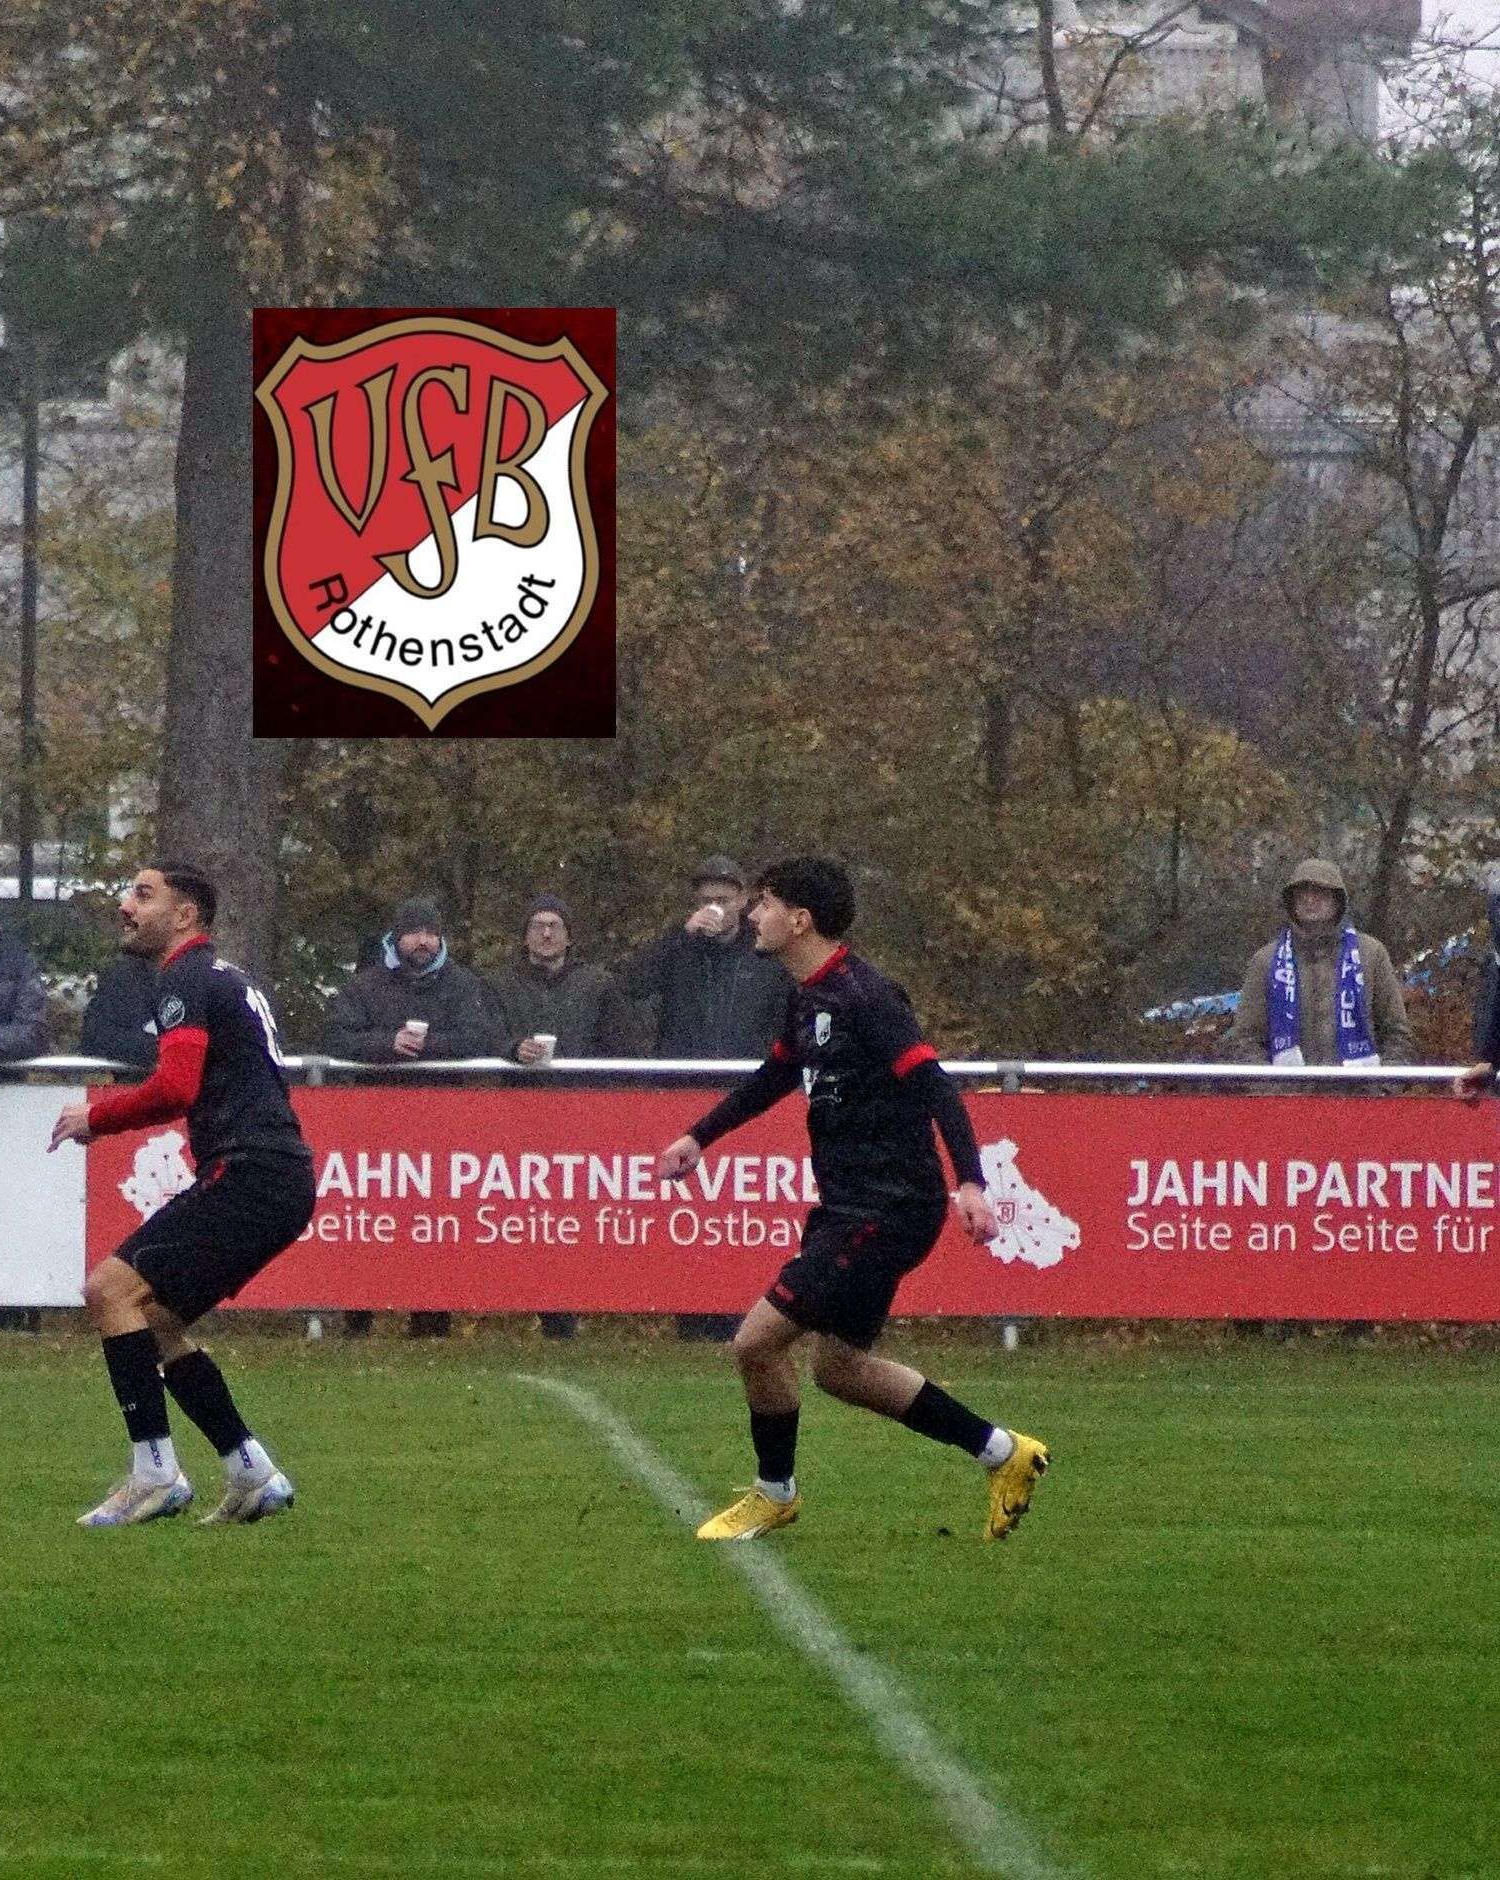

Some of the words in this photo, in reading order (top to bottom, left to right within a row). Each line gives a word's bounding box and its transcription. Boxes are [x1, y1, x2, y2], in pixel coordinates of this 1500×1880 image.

[315, 1151, 432, 1200] AHN
[1127, 1158, 1269, 1207] JAHN
[411, 1213, 460, 1243] an
[475, 1205, 581, 1245] Seite
[595, 1206, 655, 1246] für
[1126, 1211, 1232, 1252] Seite
[1248, 1221, 1297, 1252] an
[1312, 1212, 1419, 1253] Seite
[1433, 1213, 1495, 1254] für
